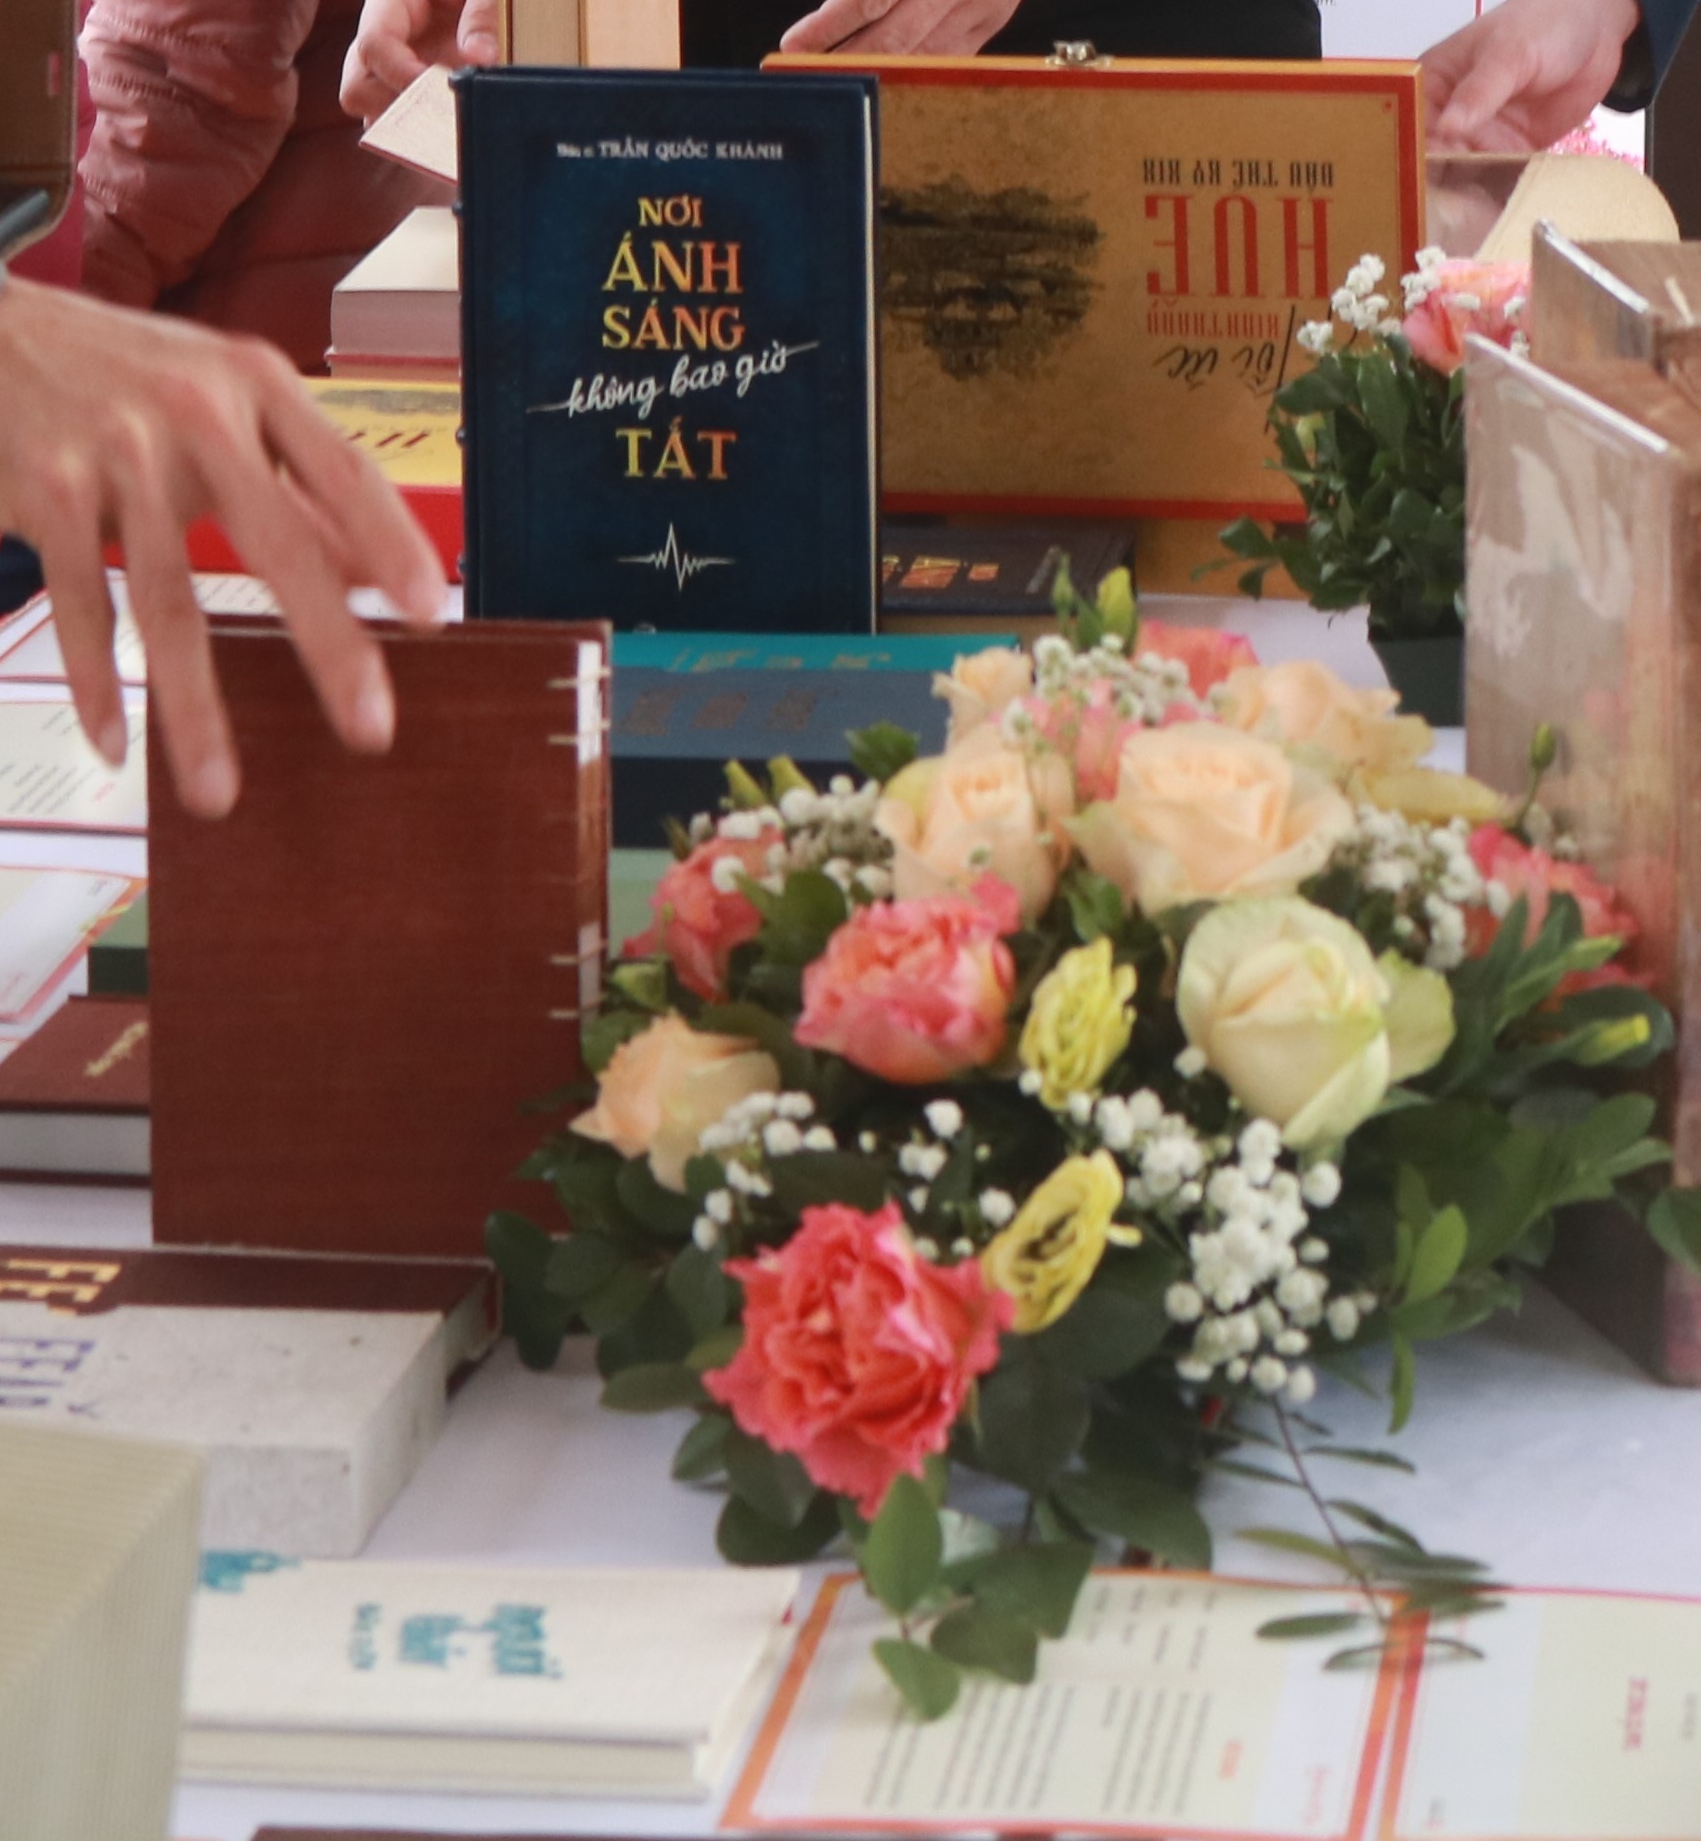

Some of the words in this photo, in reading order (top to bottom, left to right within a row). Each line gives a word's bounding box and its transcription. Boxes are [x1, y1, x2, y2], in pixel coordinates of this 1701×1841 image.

[599, 135, 649, 158] TRẦN
[655, 137, 708, 161] QUỐC
[716, 139, 783, 159] KHÁNH
[638, 193, 703, 228] NƠI
[602, 231, 743, 293] ÁNH
[1144, 192, 1334, 308] HUẾ
[602, 297, 746, 351] SÁNG
[568, 371, 664, 420] không
[669, 354, 728, 398] bao
[735, 340, 787, 398] giờ
[616, 415, 737, 480] TẮT
